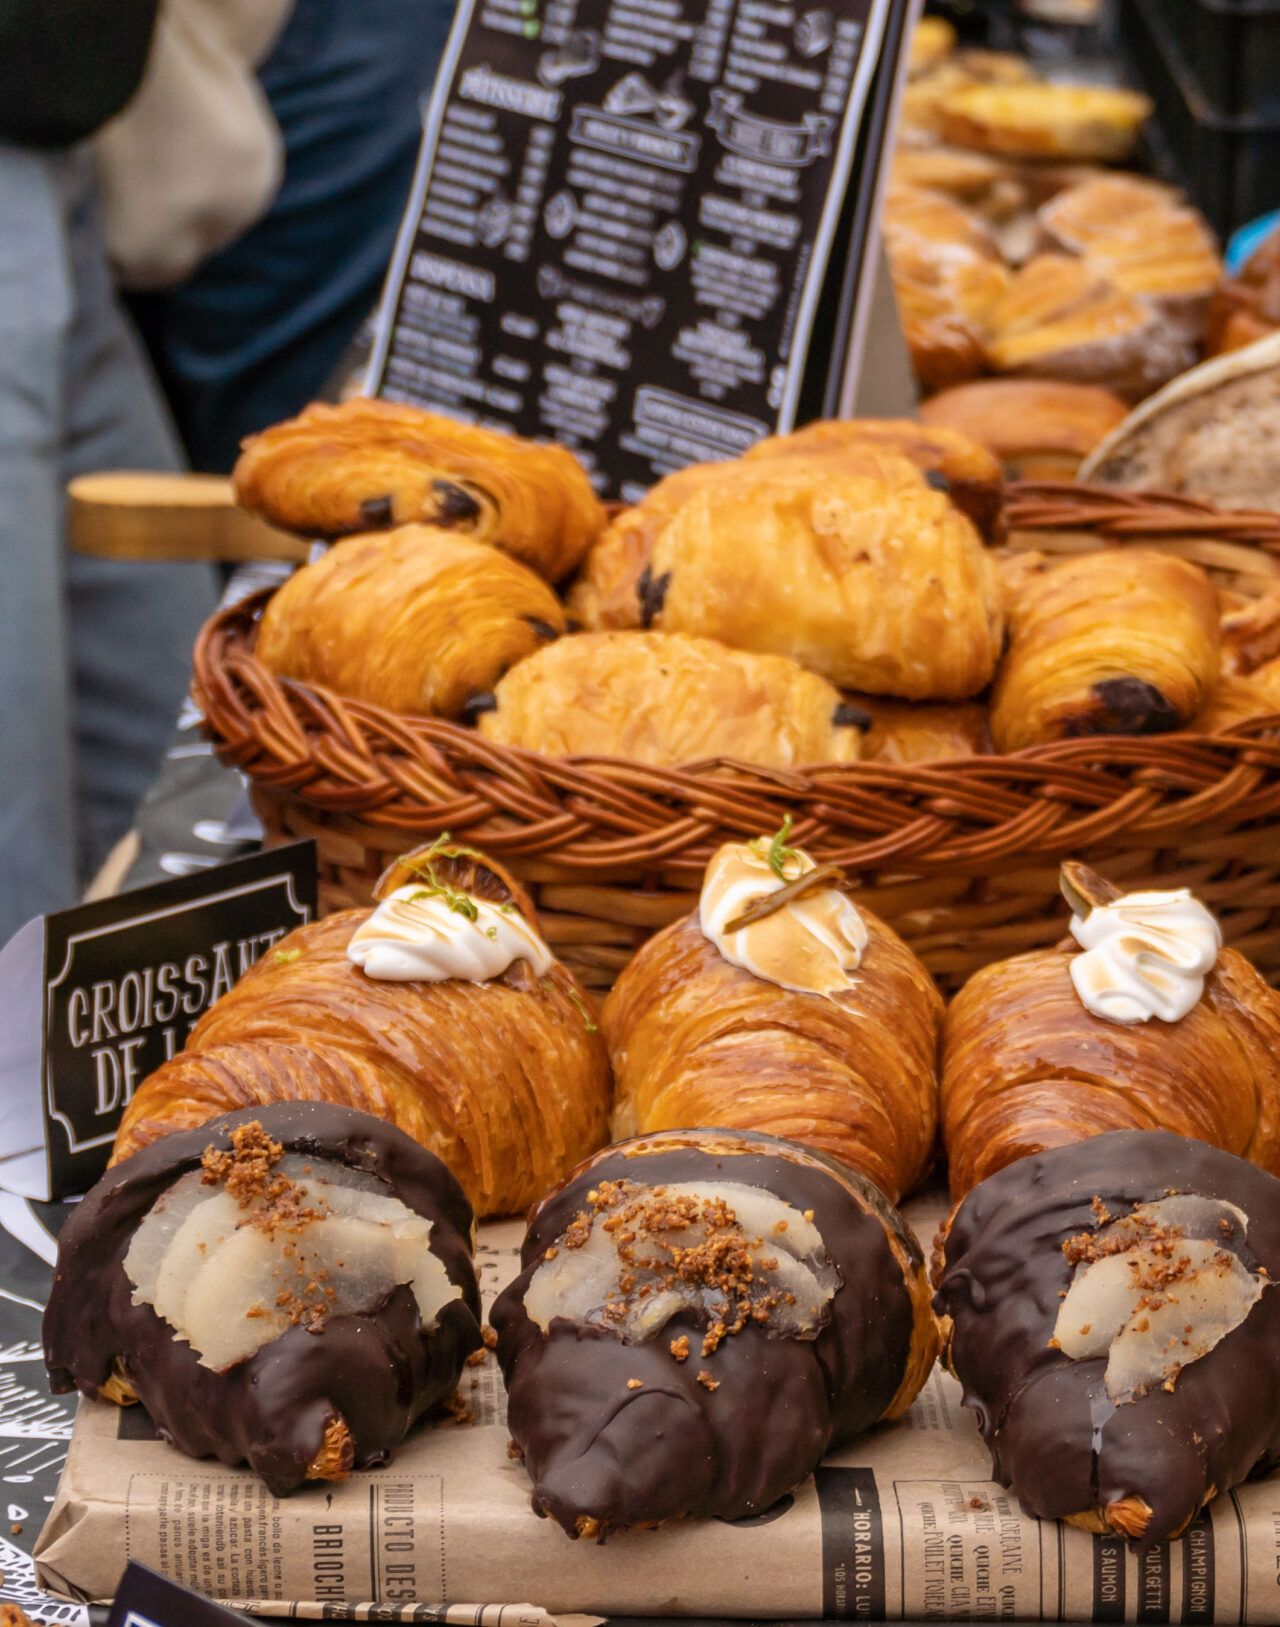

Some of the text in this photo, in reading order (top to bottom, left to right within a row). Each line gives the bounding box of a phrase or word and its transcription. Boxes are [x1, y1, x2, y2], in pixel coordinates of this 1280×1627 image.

[92, 1036, 146, 1116] DE
[188, 1512, 198, 1536] suele
[242, 1518, 254, 1543] pasta
[917, 1502, 936, 1530] QUICHE
[188, 1538, 198, 1572] adoptar
[200, 1526, 212, 1548] miga
[258, 1522, 268, 1558] francés
[924, 1532, 944, 1575] POULET
[1000, 1518, 1022, 1574] LORRAINE
[203, 1552, 210, 1562] es
[204, 1565, 212, 1575] de
[244, 1548, 253, 1565] con
[946, 1534, 964, 1584] QUICHE
[973, 1545, 990, 1592] QUICHE
[1100, 1548, 1117, 1602] SAUMON
[1190, 1530, 1208, 1612] CHAMPIGNON
[386, 1564, 416, 1602] DES
[1144, 1545, 1162, 1610] OURGETTE
